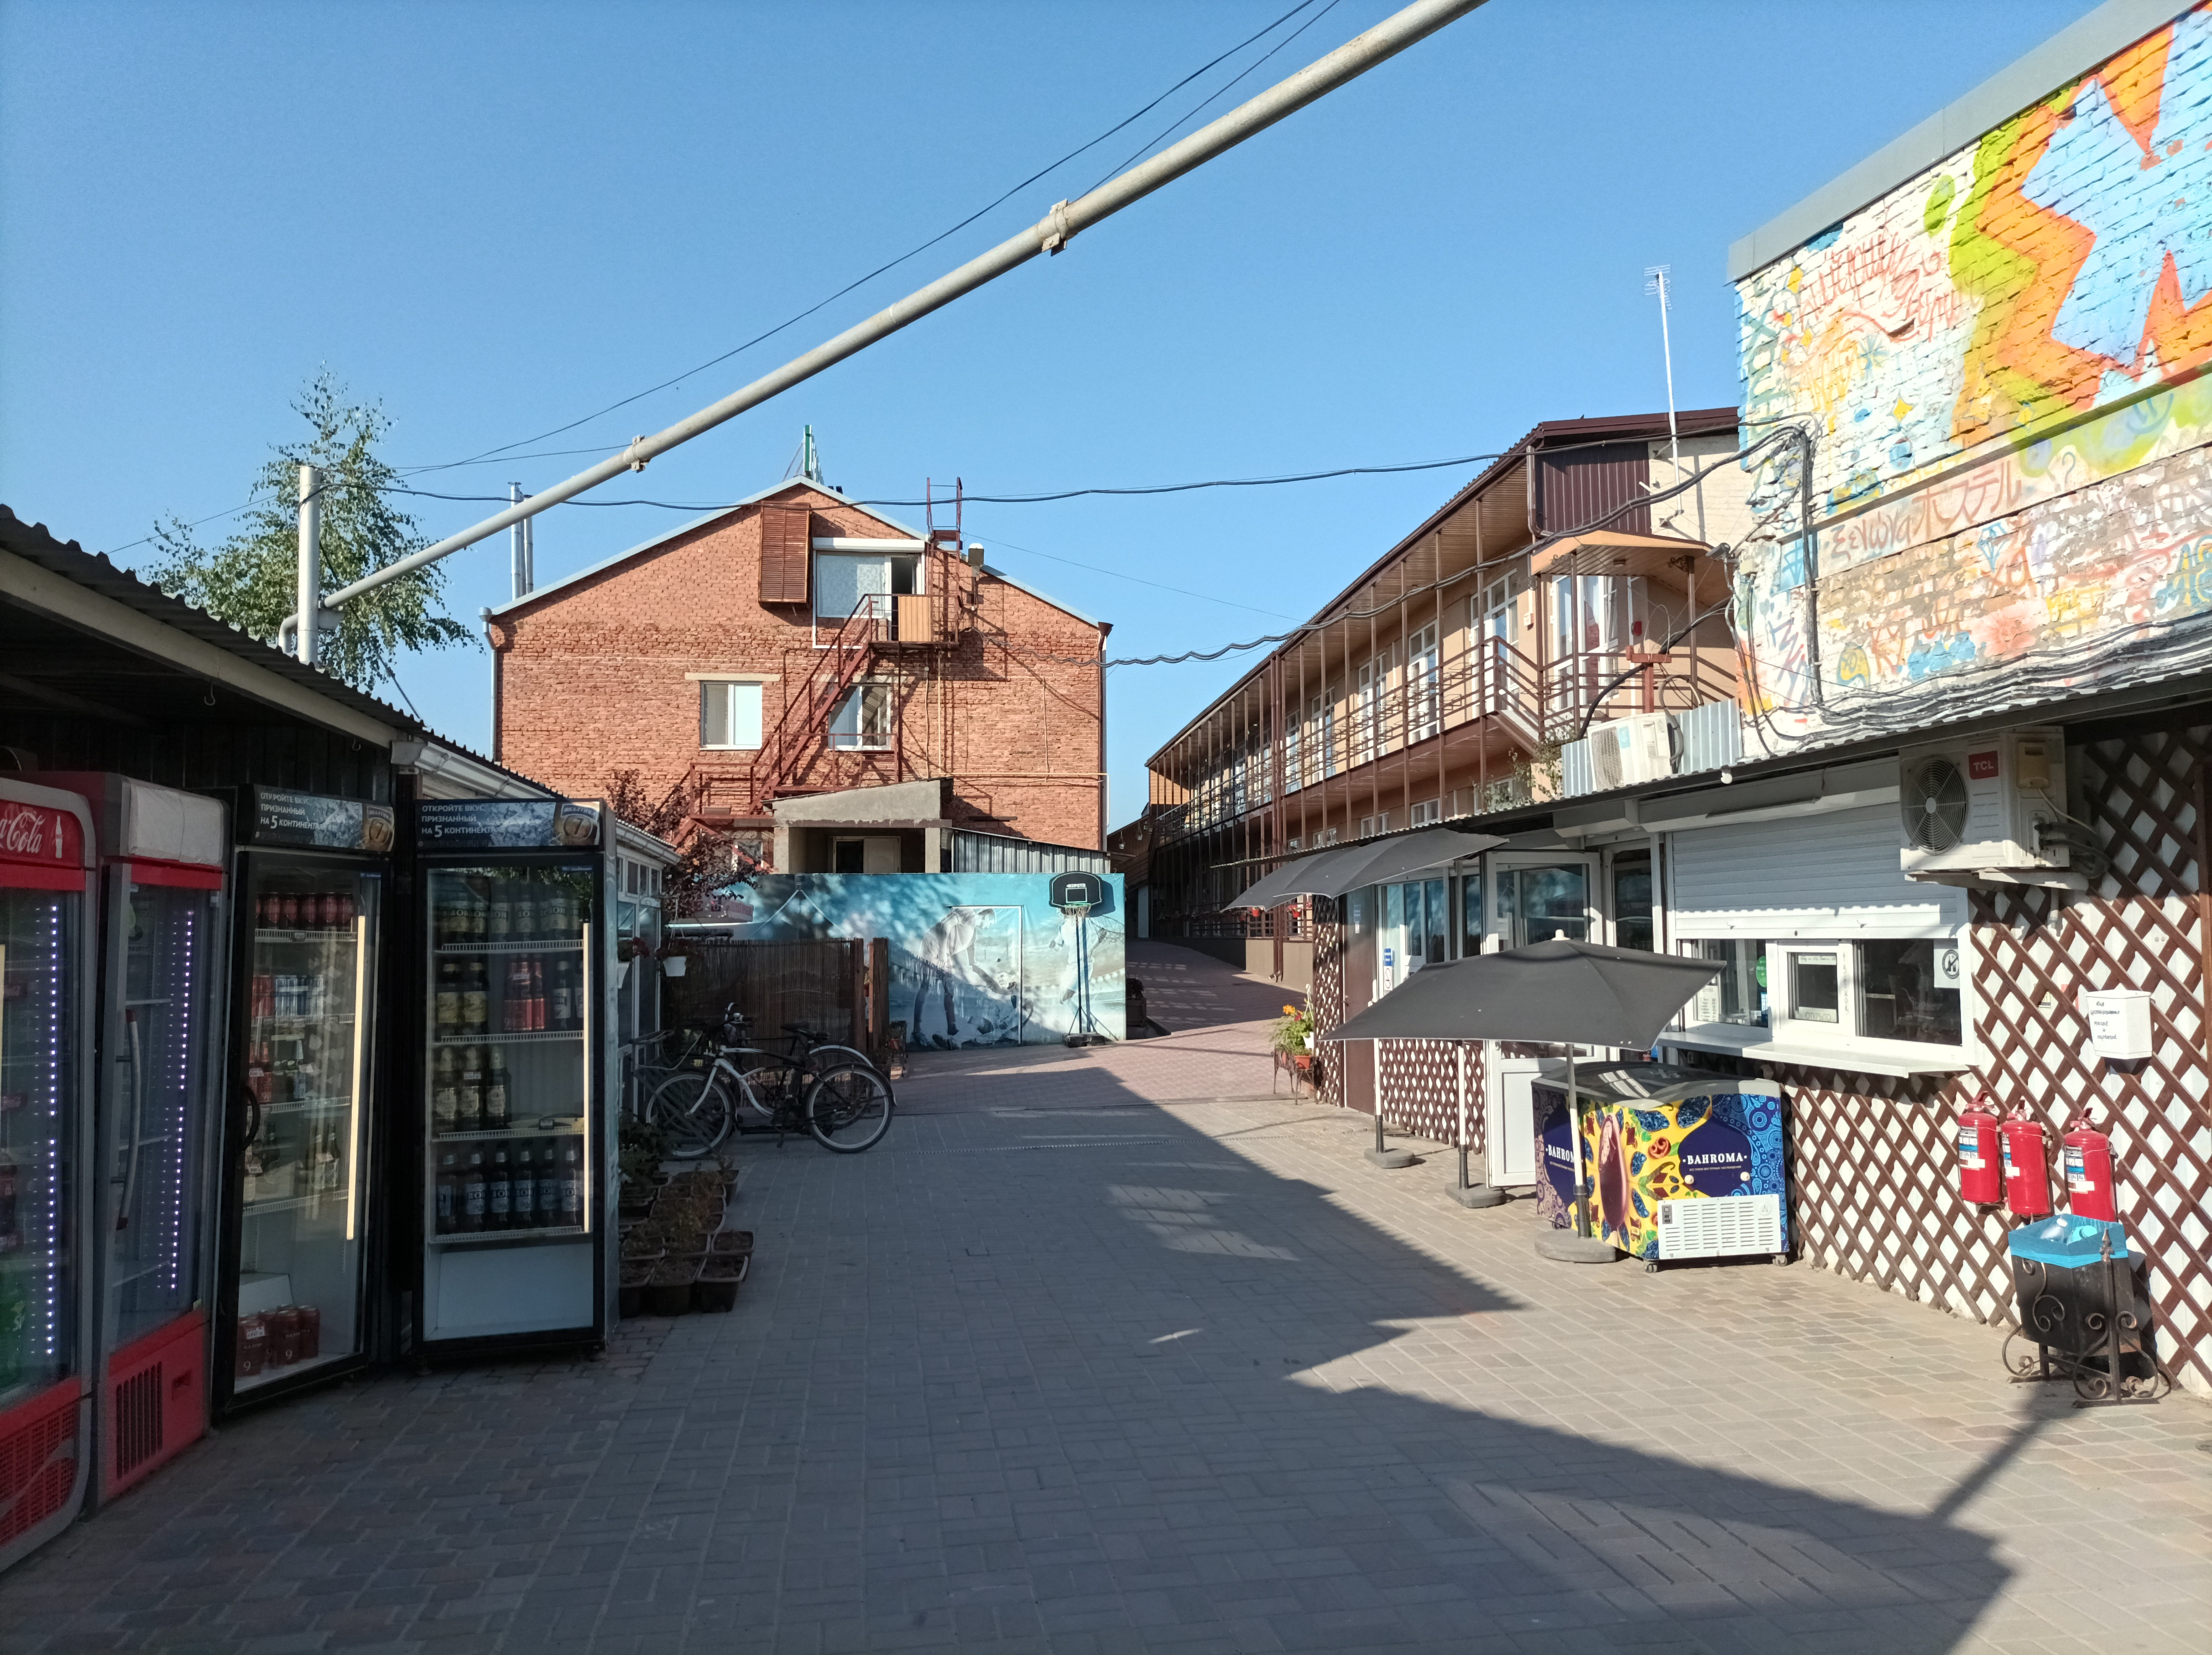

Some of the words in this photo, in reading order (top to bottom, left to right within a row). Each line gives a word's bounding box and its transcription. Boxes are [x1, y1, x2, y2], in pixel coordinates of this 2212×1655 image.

[1912, 460, 2022, 538] ホステル
[1973, 761, 1994, 771] TCL
[260, 793, 294, 803] ОТКРОЙТЕ
[260, 804, 305, 815] ПРИЗНАННЫЙ
[270, 815, 278, 829] 5
[421, 814, 477, 823] ПРИЗНАННЫЙ
[434, 825, 442, 837] 5
[1805, 1012, 1832, 1022] ОТКРЫТО
[1547, 1144, 1575, 1164] BAHROM
[1687, 1152, 1744, 1165] BAHROMA
[285, 1349, 293, 1360] 9
[243, 1361, 251, 1372] 9
